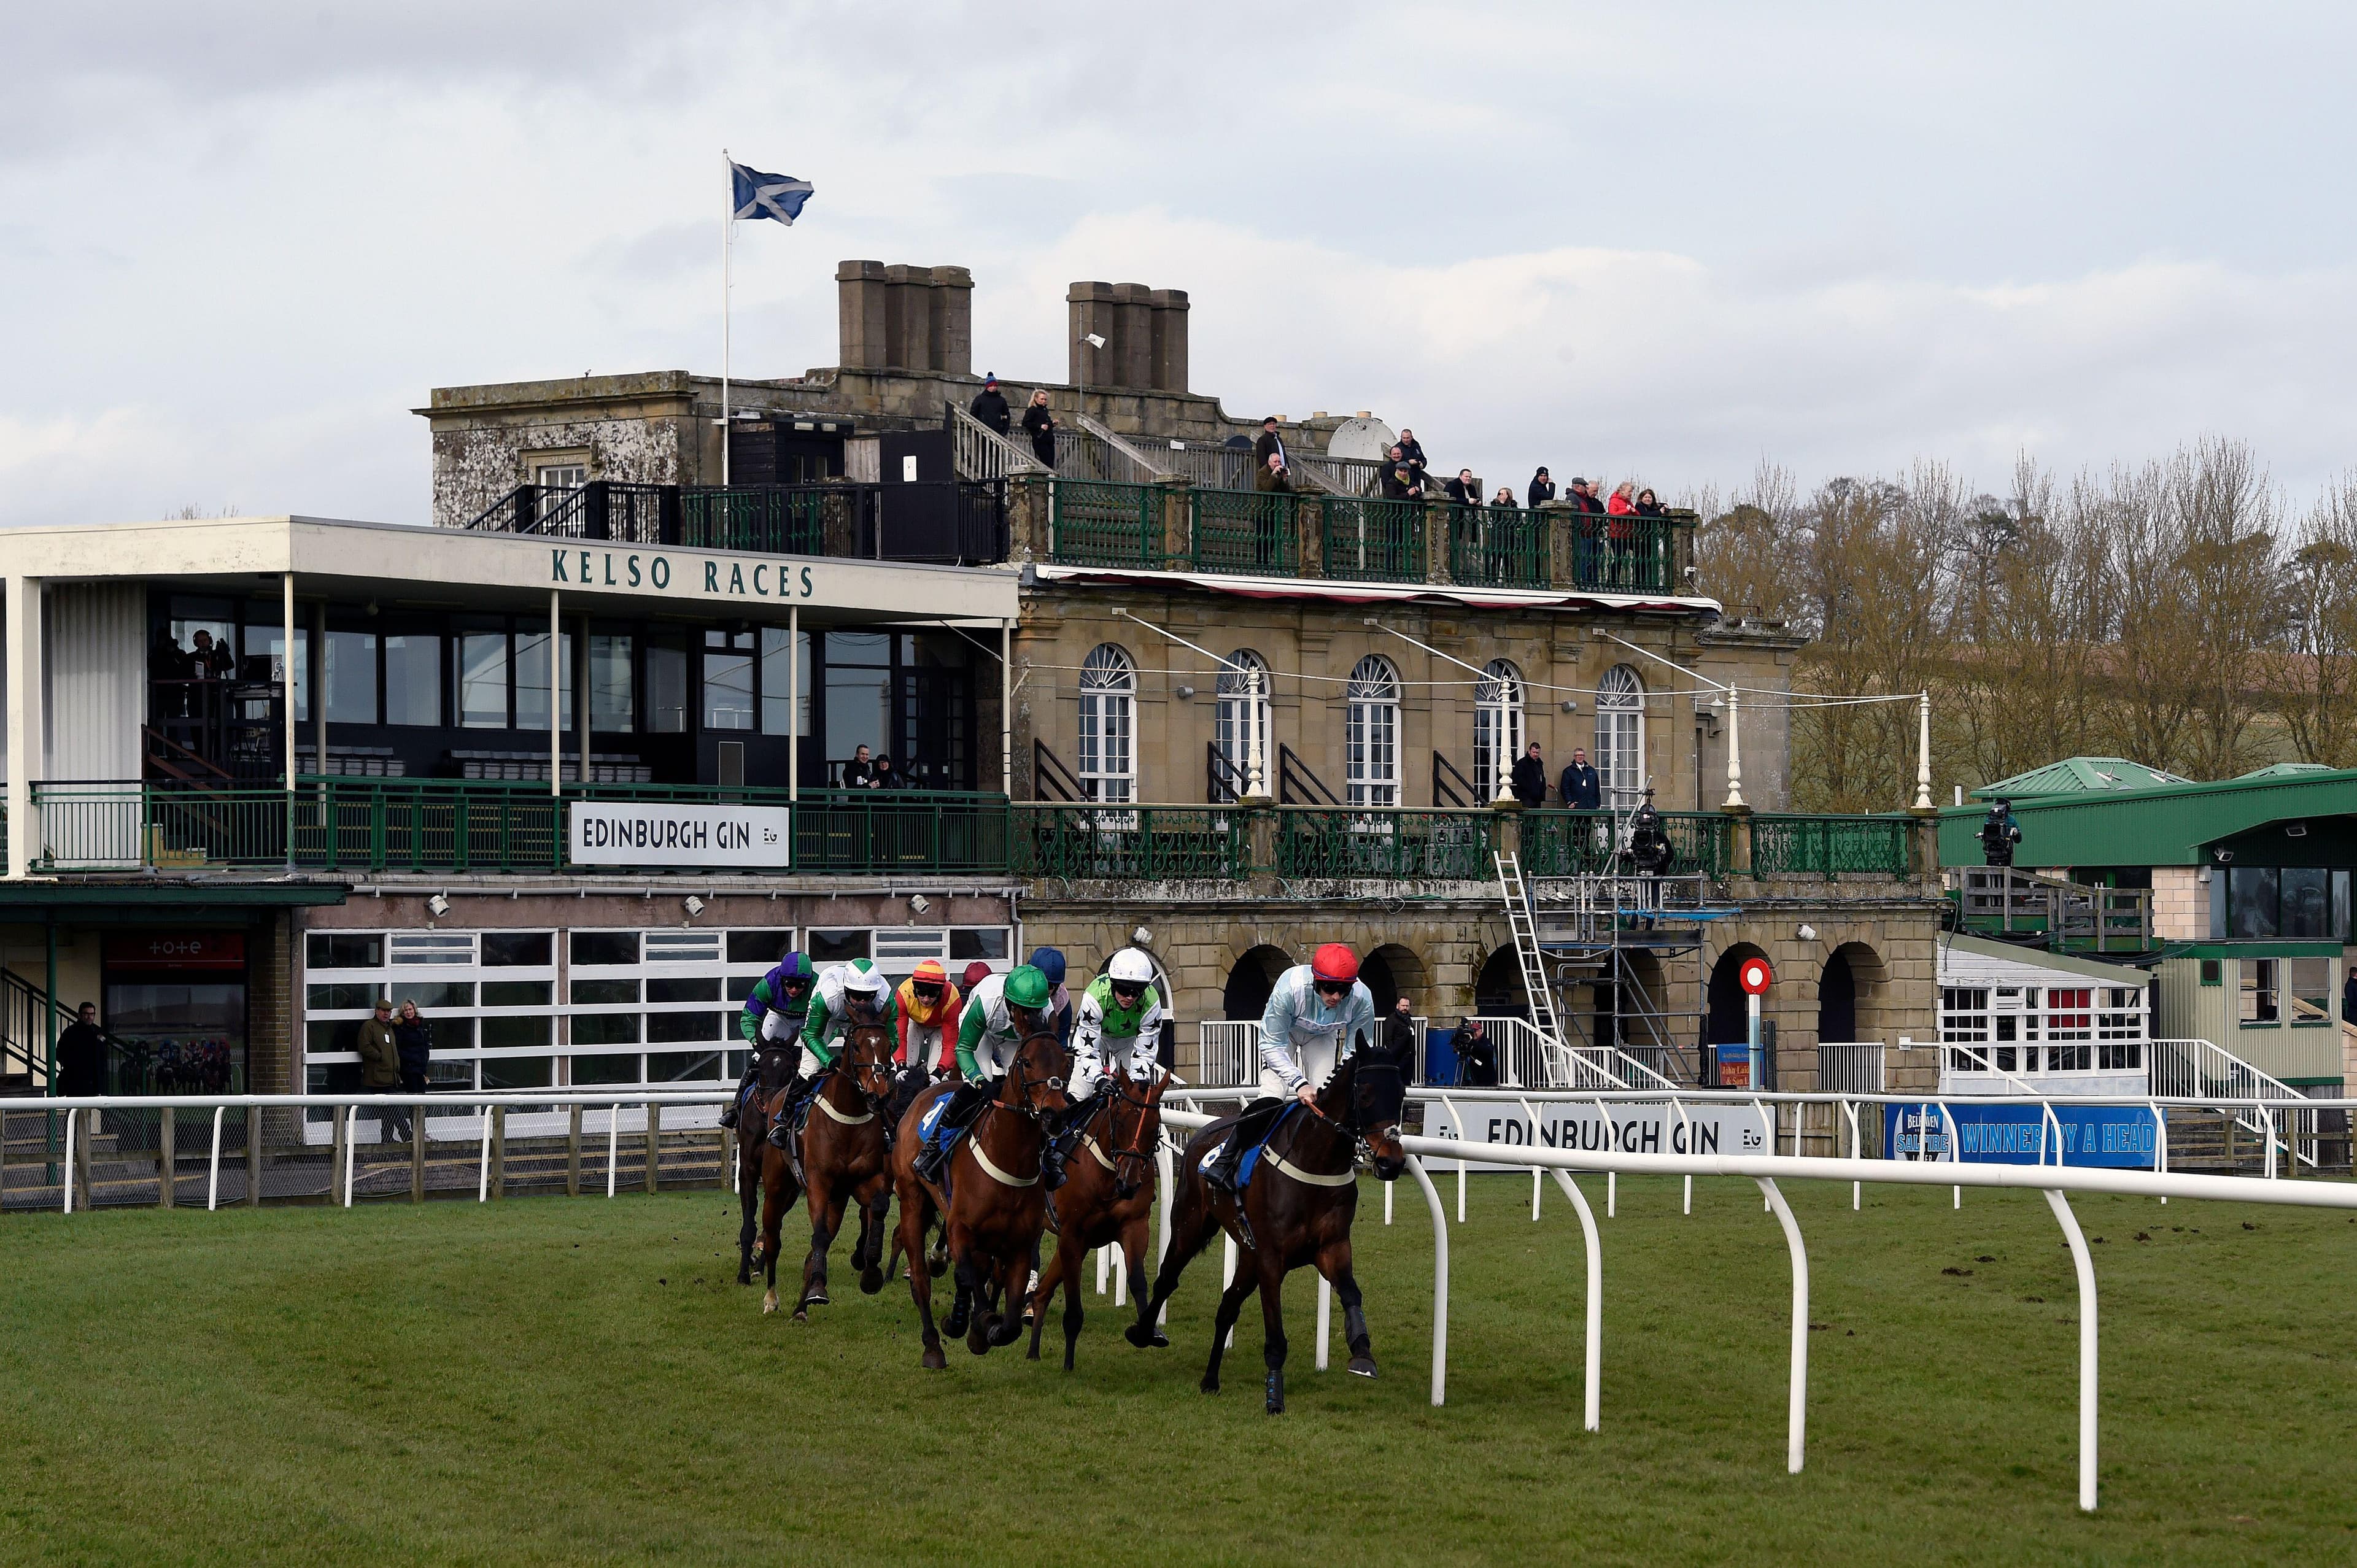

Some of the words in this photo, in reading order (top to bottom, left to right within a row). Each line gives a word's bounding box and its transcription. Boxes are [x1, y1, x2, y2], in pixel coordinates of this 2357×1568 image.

[551, 549, 671, 590] KELSO
[704, 560, 813, 598] RACES
[583, 818, 708, 849] EDINBURGH
[716, 821, 750, 849] GIN
[149, 941, 202, 955] tote
[1722, 1065, 1736, 1075] John
[1732, 1076, 1743, 1085] Son
[922, 1100, 945, 1132] 4
[1673, 1121, 1719, 1154] GIN
[1962, 1123, 2043, 1153] WINNER
[2050, 1124, 2077, 1153] BY
[2082, 1124, 2096, 1153] A
[2102, 1124, 2155, 1153] HEAD
